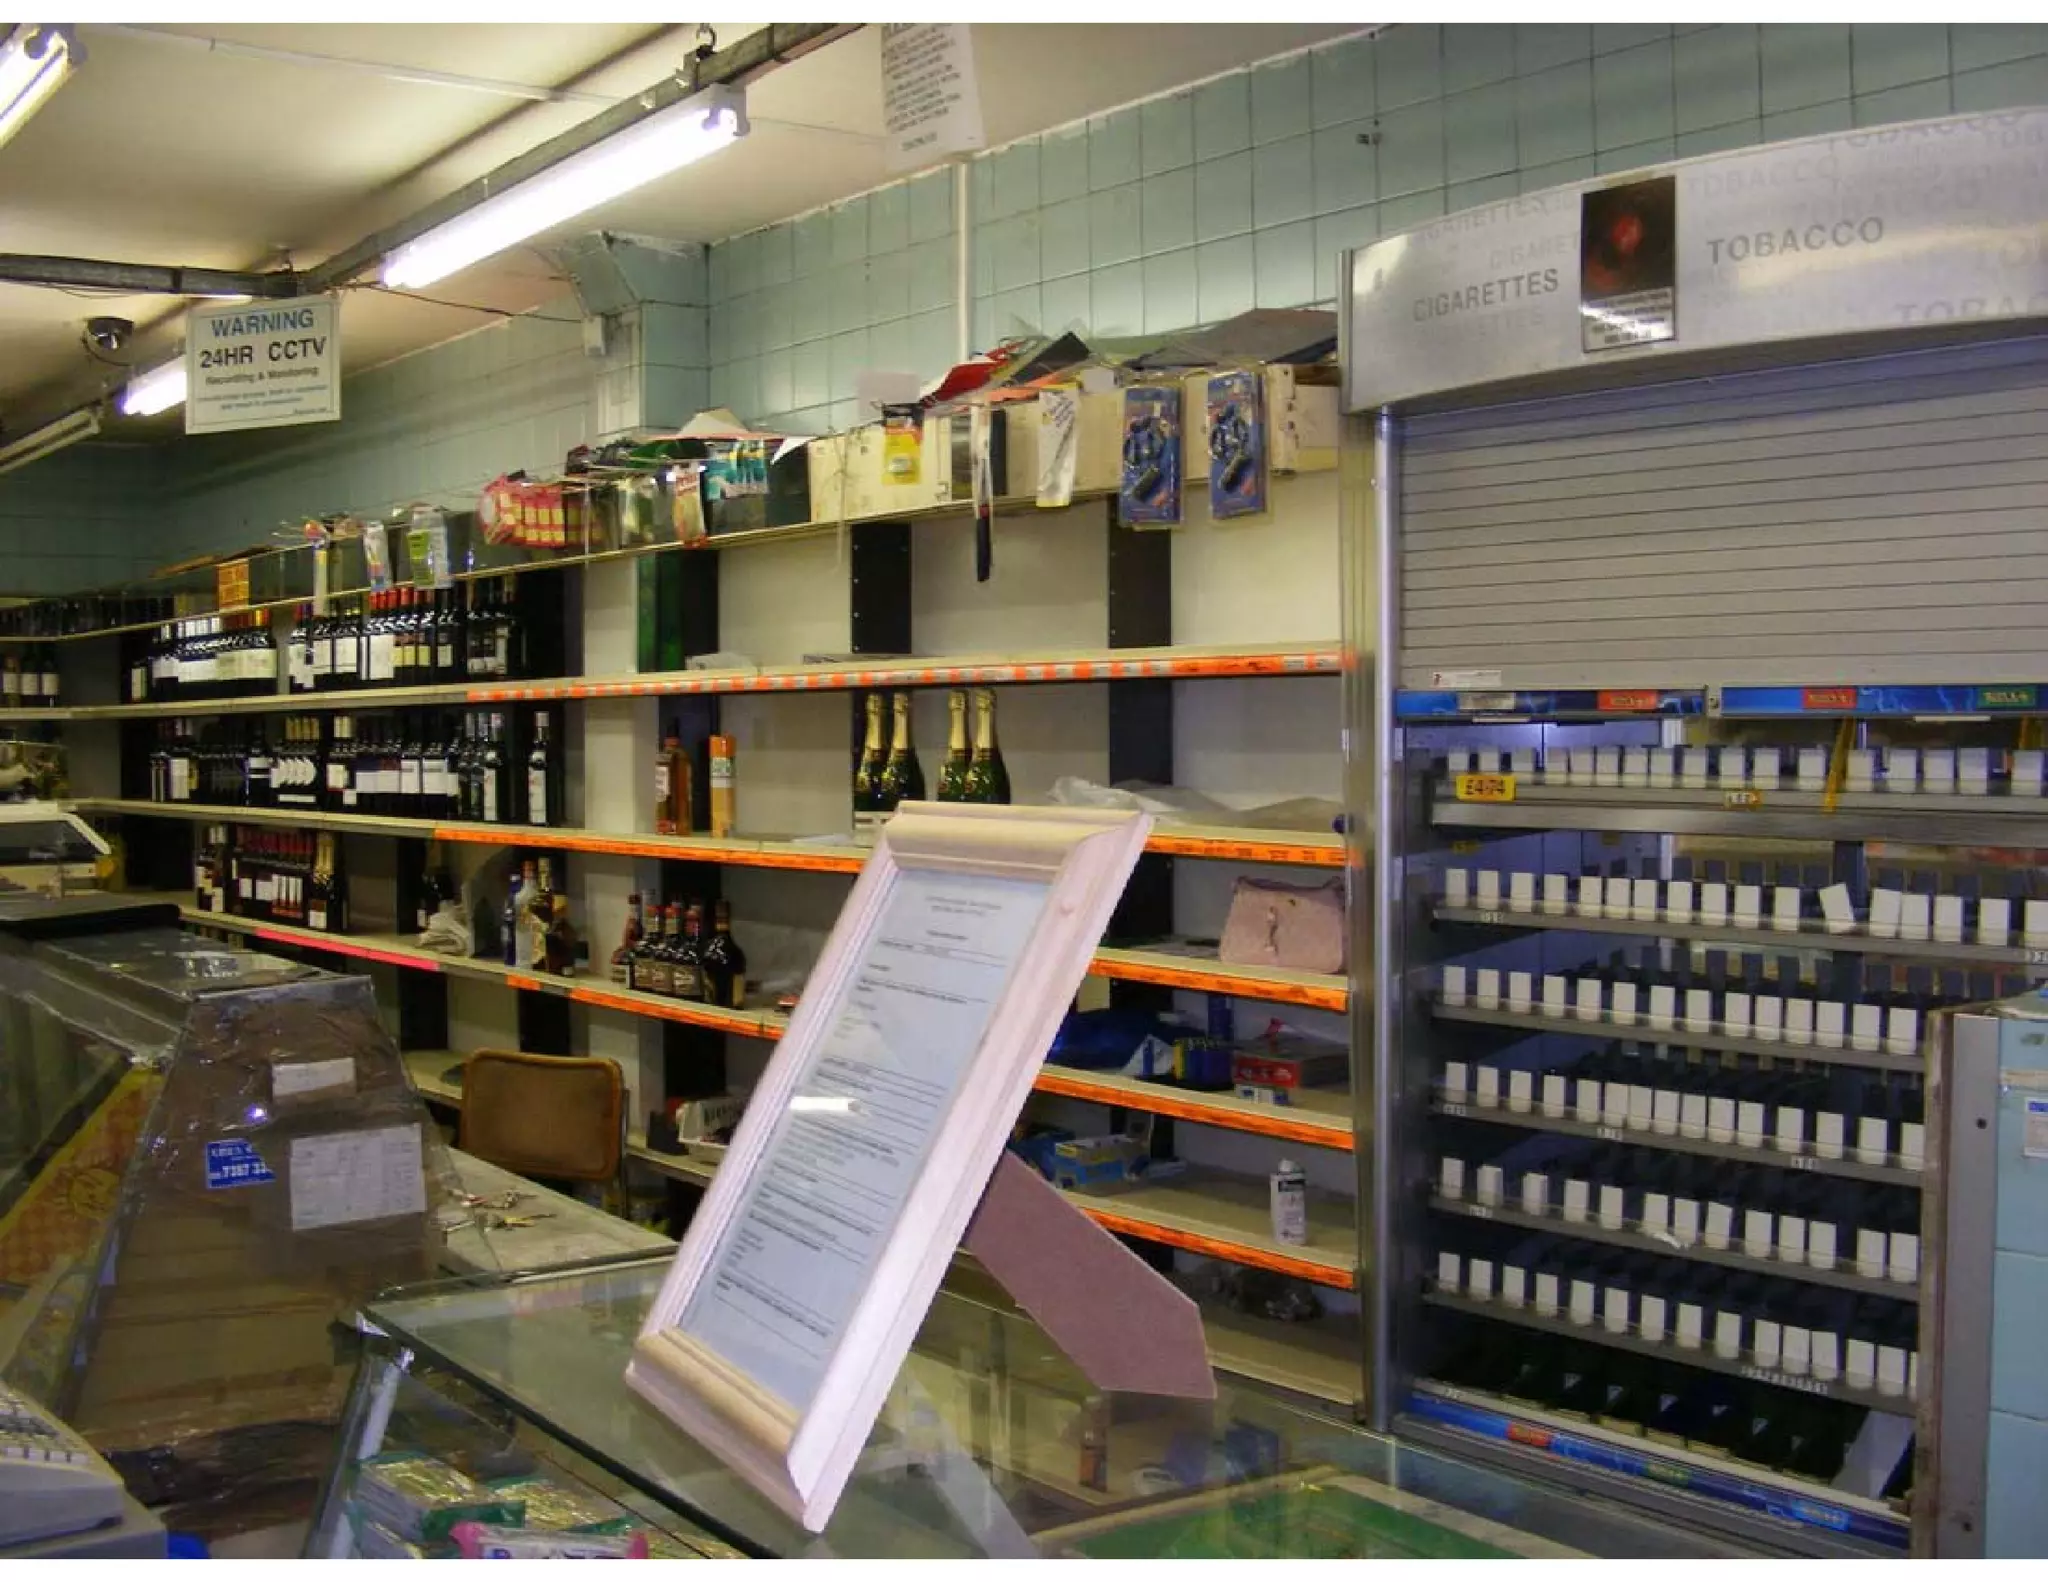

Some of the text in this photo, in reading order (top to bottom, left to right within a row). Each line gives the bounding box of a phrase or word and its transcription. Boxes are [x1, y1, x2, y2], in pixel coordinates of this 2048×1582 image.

[1706, 215, 1884, 265] TOBACCO
[1412, 267, 1559, 323] CIGARETTES
[211, 308, 314, 337] WARNING
[200, 336, 327, 369] 24HR CCTV
